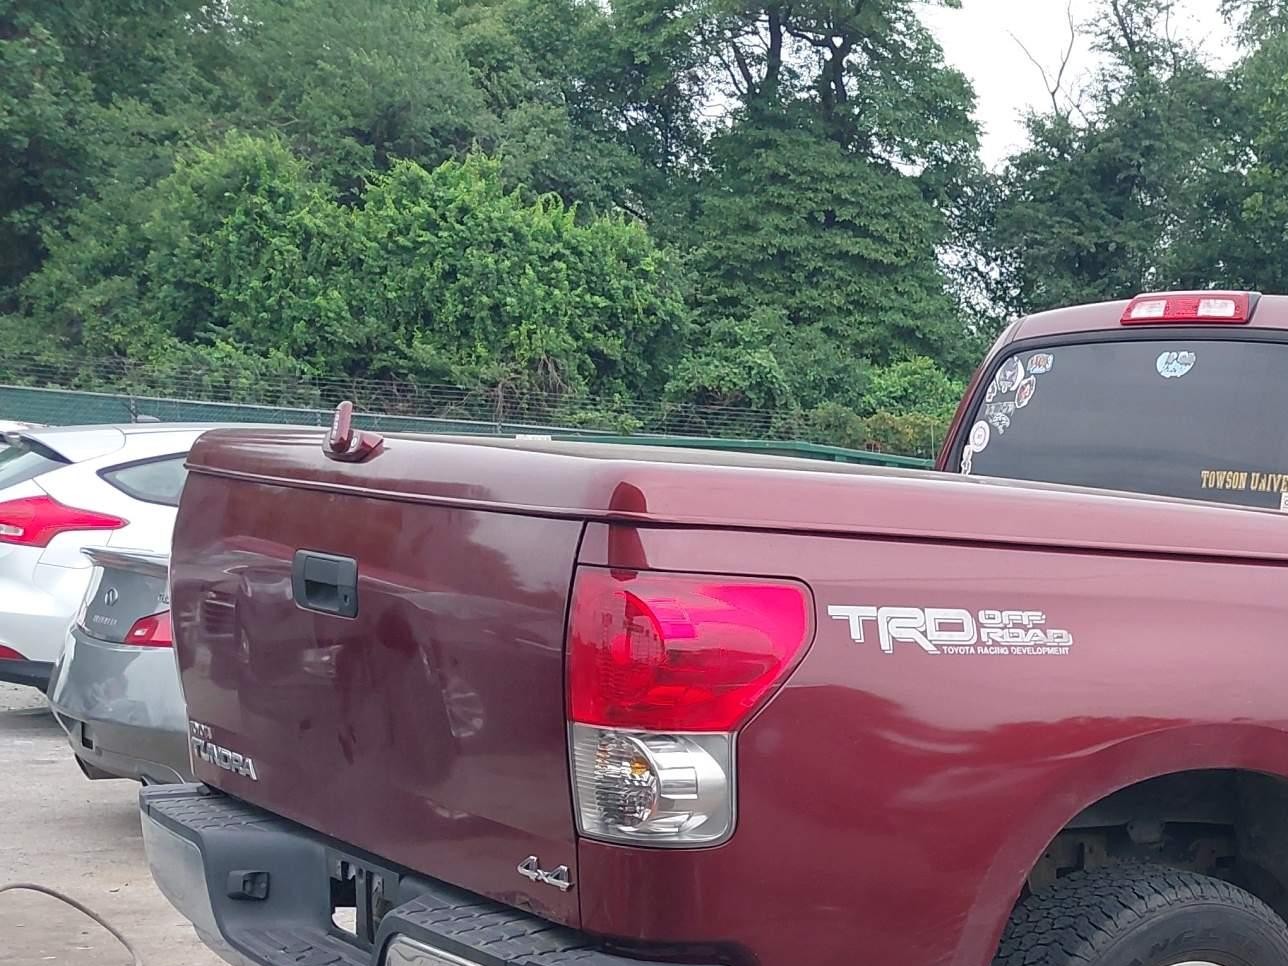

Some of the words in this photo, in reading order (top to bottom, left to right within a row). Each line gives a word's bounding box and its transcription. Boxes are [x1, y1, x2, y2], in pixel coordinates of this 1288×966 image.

[1200, 470, 1248, 490] TOWSON
[978, 609, 1046, 628] OFF
[827, 604, 978, 654] TRD
[980, 627, 1073, 646] ROAD
[942, 646, 976, 655] TOYOTA
[977, 646, 1009, 655] RACING
[1011, 646, 1070, 656] DEVELOPMENT
[191, 736, 258, 781] TUNDRA
